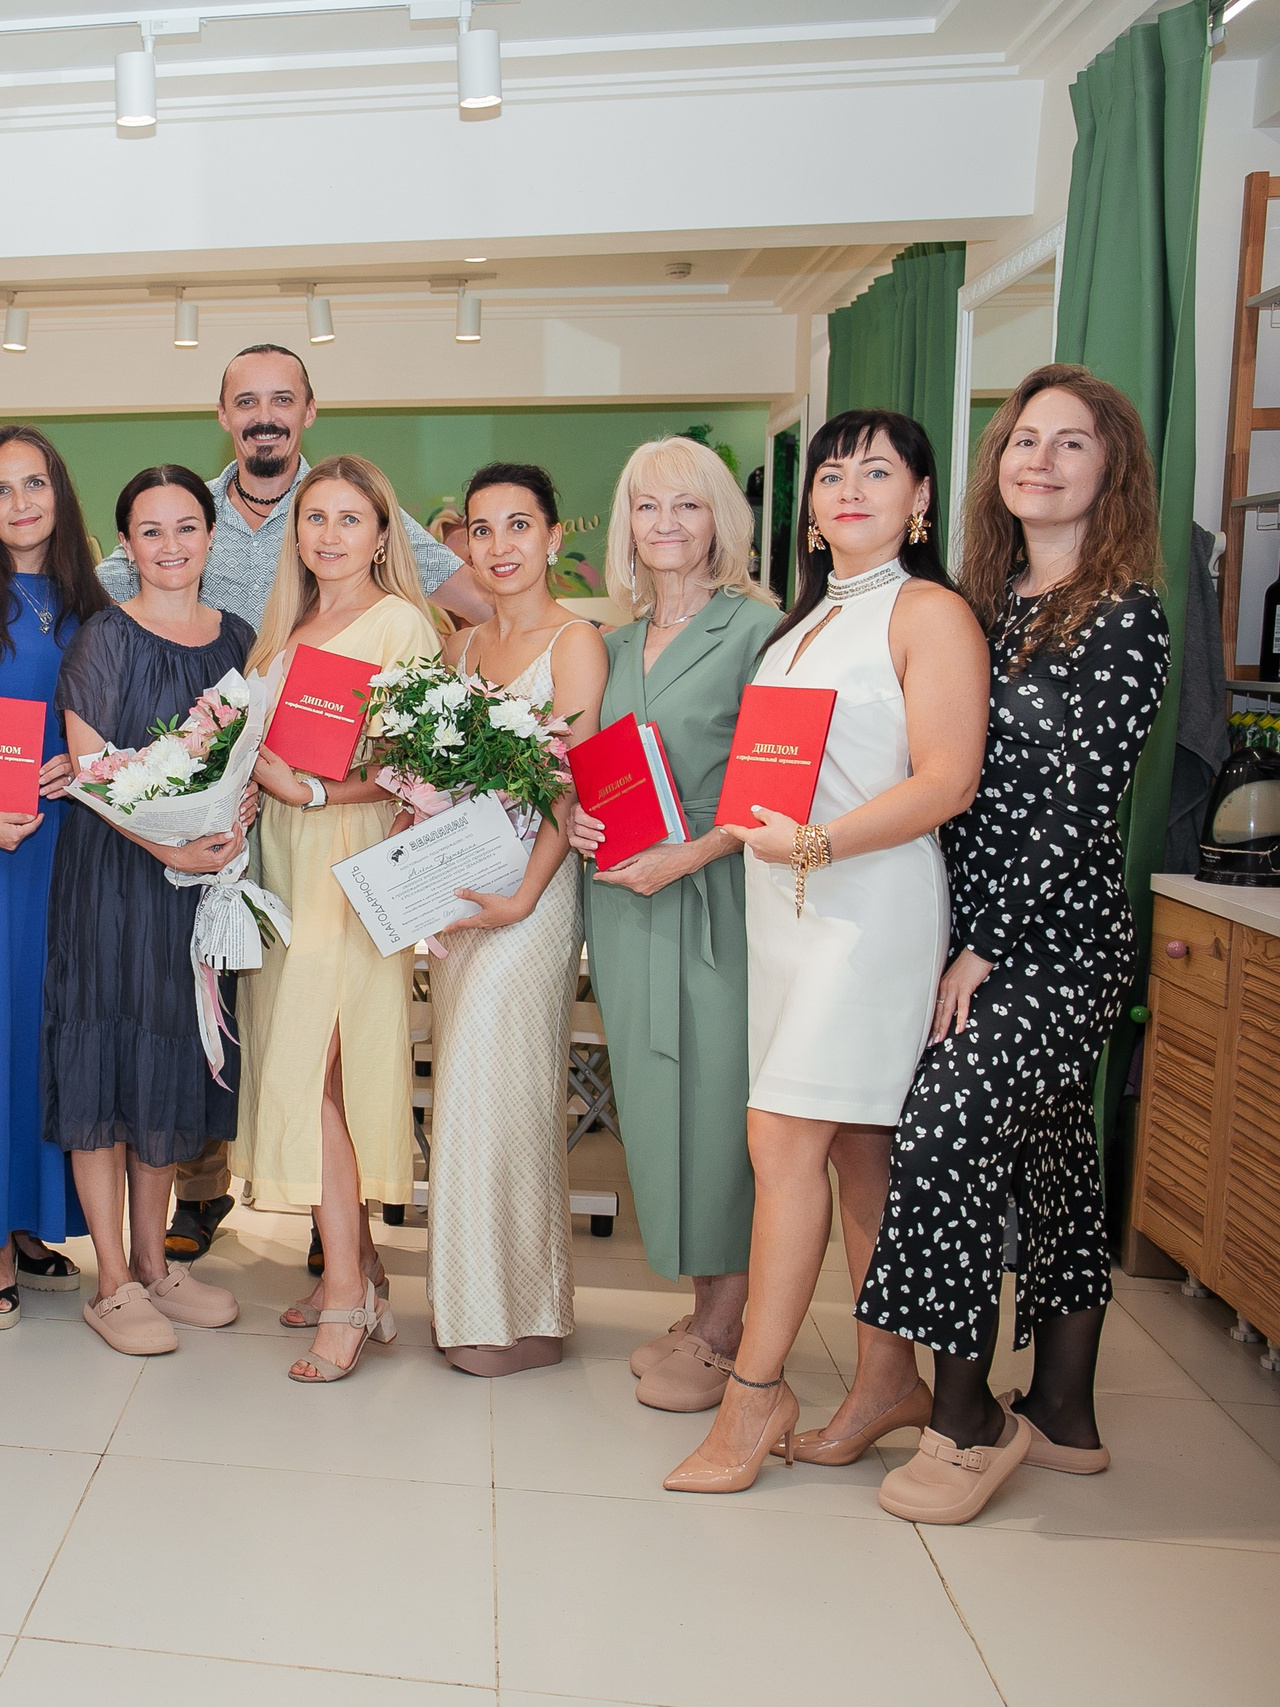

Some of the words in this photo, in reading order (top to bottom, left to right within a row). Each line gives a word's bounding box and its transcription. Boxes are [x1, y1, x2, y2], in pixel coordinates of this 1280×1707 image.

[300, 694, 344, 712] ДИПЛОМ
[752, 743, 799, 755] ДИПЛОМ
[599, 773, 632, 800] ДИПЛОМ
[407, 815, 469, 851] ЗЕМЛЯНИН
[351, 865, 401, 943] БЛАГОДАРНОСТЬ
